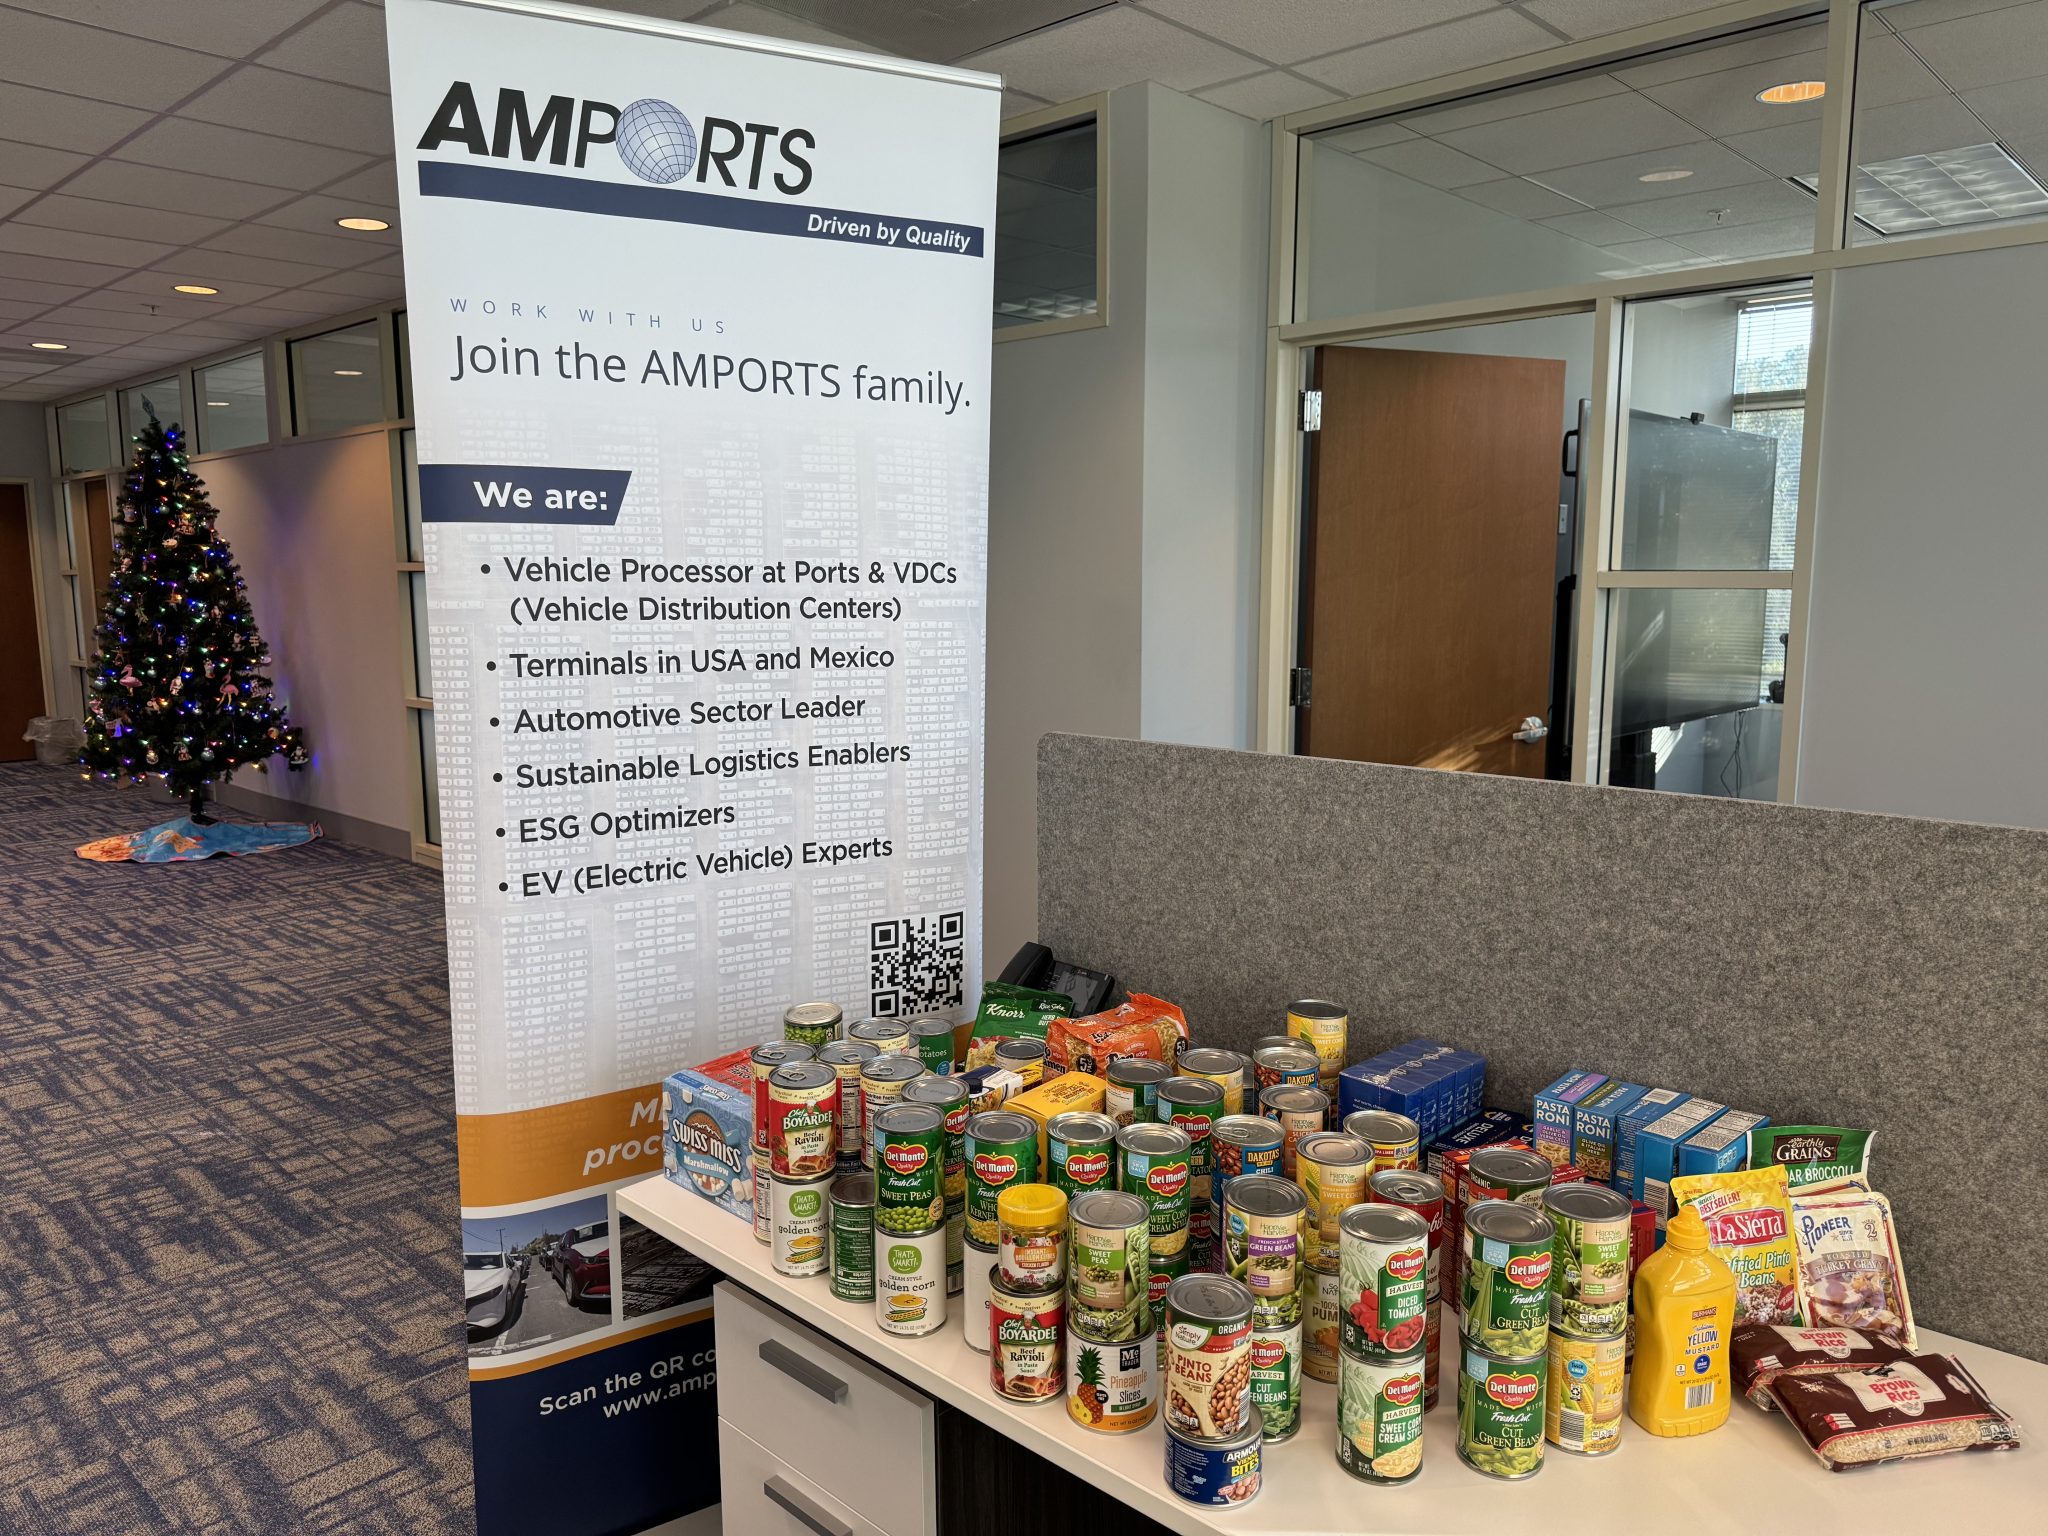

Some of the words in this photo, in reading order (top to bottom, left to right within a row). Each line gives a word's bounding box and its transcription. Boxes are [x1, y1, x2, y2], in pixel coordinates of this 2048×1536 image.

[807, 214, 871, 239] Driven
[876, 223, 900, 245] by
[905, 225, 971, 253] Quality
[450, 297, 548, 319] WORK
[579, 308, 661, 329] WITH
[692, 318, 726, 334] US
[450, 335, 540, 381] Join
[555, 341, 627, 382] the
[641, 348, 840, 397] AMPORTS
[852, 365, 972, 415] family.
[473, 481, 533, 508] We
[544, 486, 608, 512] are:
[503, 556, 610, 582] Vehicle
[620, 559, 754, 584] Processor
[762, 563, 786, 583] at
[794, 561, 860, 583] Ports
[869, 563, 885, 583] &
[893, 563, 957, 584] VDCs
[510, 597, 628, 625] (Vehicle
[638, 596, 790, 622] Distribution
[799, 596, 902, 622] Centers)
[510, 651, 647, 678] Terminals
[658, 650, 681, 673] in
[690, 649, 746, 672] USA
[755, 648, 801, 671] and
[810, 646, 895, 669] Mexico
[513, 706, 680, 734] Automotive
[690, 699, 773, 725] Sector
[780, 695, 866, 720] Leader
[516, 759, 680, 788] Sustainable
[689, 748, 799, 780] Logistics
[808, 742, 911, 767] Enablers
[519, 818, 580, 843] ESG
[590, 805, 735, 839] Optimizers
[521, 871, 563, 897] EV
[574, 858, 687, 894] (Electric
[696, 845, 793, 876] Vehicle)
[802, 837, 893, 868] Experts
[986, 1003, 1025, 1018] Knorr
[1536, 1099, 1570, 1115] PASTA
[783, 1110, 833, 1130] BOYARDEE
[1536, 1109, 1570, 1126] RONI
[1577, 1112, 1611, 1128] PASTA
[1185, 1121, 1210, 1131] Monte
[1576, 1121, 1610, 1139] RONI
[672, 1118, 708, 1153] SWISS
[710, 1138, 742, 1173] MISS
[794, 1133, 824, 1146] Ravioli
[1581, 1138, 1597, 1146] OLIVE
[1792, 1137, 1825, 1148] earthly
[582, 1135, 662, 1176] proc
[886, 1151, 899, 1160] Del
[899, 1151, 925, 1161] Monte
[1247, 1148, 1280, 1163] DAKOTA'S
[1776, 1144, 1832, 1161] GRAINS
[683, 1154, 729, 1177] Marshmallow
[976, 1160, 988, 1170] Del
[988, 1162, 1015, 1173] Monte
[1069, 1162, 1083, 1172] Del
[1083, 1161, 1107, 1172] Monte
[1255, 1166, 1274, 1175] CHILI
[1150, 1175, 1165, 1184] Del
[1165, 1171, 1187, 1183] Monte
[1805, 1165, 1854, 1182] BROCCOLI
[1059, 1180, 1079, 1188] MADE
[881, 1187, 908, 1201] SWEET
[910, 1189, 932, 1201] PEAS
[1152, 1200, 1171, 1211] Fresh
[1700, 1202, 1714, 1216] BEST
[1713, 1190, 1741, 1209] SELLER!
[970, 1205, 997, 1221] KERNEL
[778, 1225, 811, 1235] golden
[1715, 1221, 1737, 1242] La
[1735, 1214, 1783, 1240] Sierra
[1801, 1214, 1852, 1254] PIONEER
[1864, 1222, 1878, 1239] 2
[893, 1249, 915, 1258] THAT'S
[1088, 1249, 1111, 1258] SWEET
[1249, 1242, 1273, 1252] GREEN
[1274, 1241, 1295, 1252] BEANS
[1597, 1244, 1620, 1253] SWEET
[1091, 1257, 1109, 1265] PEAS
[1390, 1260, 1404, 1269] Del
[1404, 1256, 1424, 1268] Monte
[1600, 1251, 1618, 1260] PEAS
[1765, 1250, 1791, 1269] Pinto
[1826, 1251, 1870, 1261] ROASTED
[1510, 1265, 1527, 1275] Del
[1527, 1260, 1551, 1275] Monte
[1815, 1259, 1852, 1274] TURKEY
[1853, 1258, 1886, 1270] GRAVY
[879, 1279, 910, 1292] golden
[912, 1280, 936, 1292] corn
[1523, 1276, 1542, 1284] Quality
[1740, 1271, 1775, 1288] Beans
[1389, 1282, 1423, 1295] HARVEST
[1495, 1286, 1521, 1295] MADE
[1397, 1295, 1418, 1307] DICED
[1510, 1293, 1533, 1305] Fresh
[1388, 1303, 1423, 1319] TOMATOES
[1520, 1308, 1540, 1319] CUT
[1003, 1319, 1022, 1329] Chef
[1218, 1320, 1246, 1335] ORGANIC
[1496, 1317, 1531, 1329] GREEN
[999, 1325, 1057, 1342] BOYARDEE
[1687, 1330, 1718, 1347] YELLOW
[1799, 1331, 1848, 1340] Brown
[1685, 1342, 1720, 1355] MUSTARD
[1814, 1339, 1848, 1347] Rice
[1010, 1351, 1045, 1362] Ravioli
[1259, 1348, 1283, 1356] Monte
[1177, 1355, 1212, 1373] PINTO
[1110, 1369, 1148, 1389] Pineapple
[1175, 1363, 1212, 1383] BEANS
[539, 1385, 597, 1415] Scan
[604, 1372, 642, 1394] the
[650, 1355, 684, 1379] QR
[692, 1349, 716, 1367] co
[1256, 1383, 1272, 1393] CUT
[1387, 1386, 1400, 1395] Del
[1400, 1382, 1420, 1394] Monte
[1490, 1382, 1507, 1393] Del
[1508, 1382, 1536, 1395] Monte
[1868, 1379, 1919, 1394] Brown
[603, 1371, 716, 1418] www.amp
[1119, 1390, 1141, 1403] Slices
[1264, 1391, 1287, 1403] BEANS
[1503, 1395, 1524, 1403] Quality
[1886, 1389, 1921, 1403] Rice
[1477, 1400, 1500, 1411] MADE
[1385, 1406, 1420, 1420] HARVEST
[1490, 1411, 1515, 1422] Fresh
[1380, 1422, 1405, 1433] SWEET
[1501, 1428, 1524, 1438] CUT
[1378, 1433, 1406, 1443] CREAM
[1406, 1427, 1421, 1441] STYLE
[1479, 1431, 1511, 1448] GREEN
[1514, 1433, 1540, 1448] BEANS
[1226, 1439, 1261, 1462] ARMOU
[1231, 1459, 1259, 1477] BITES
